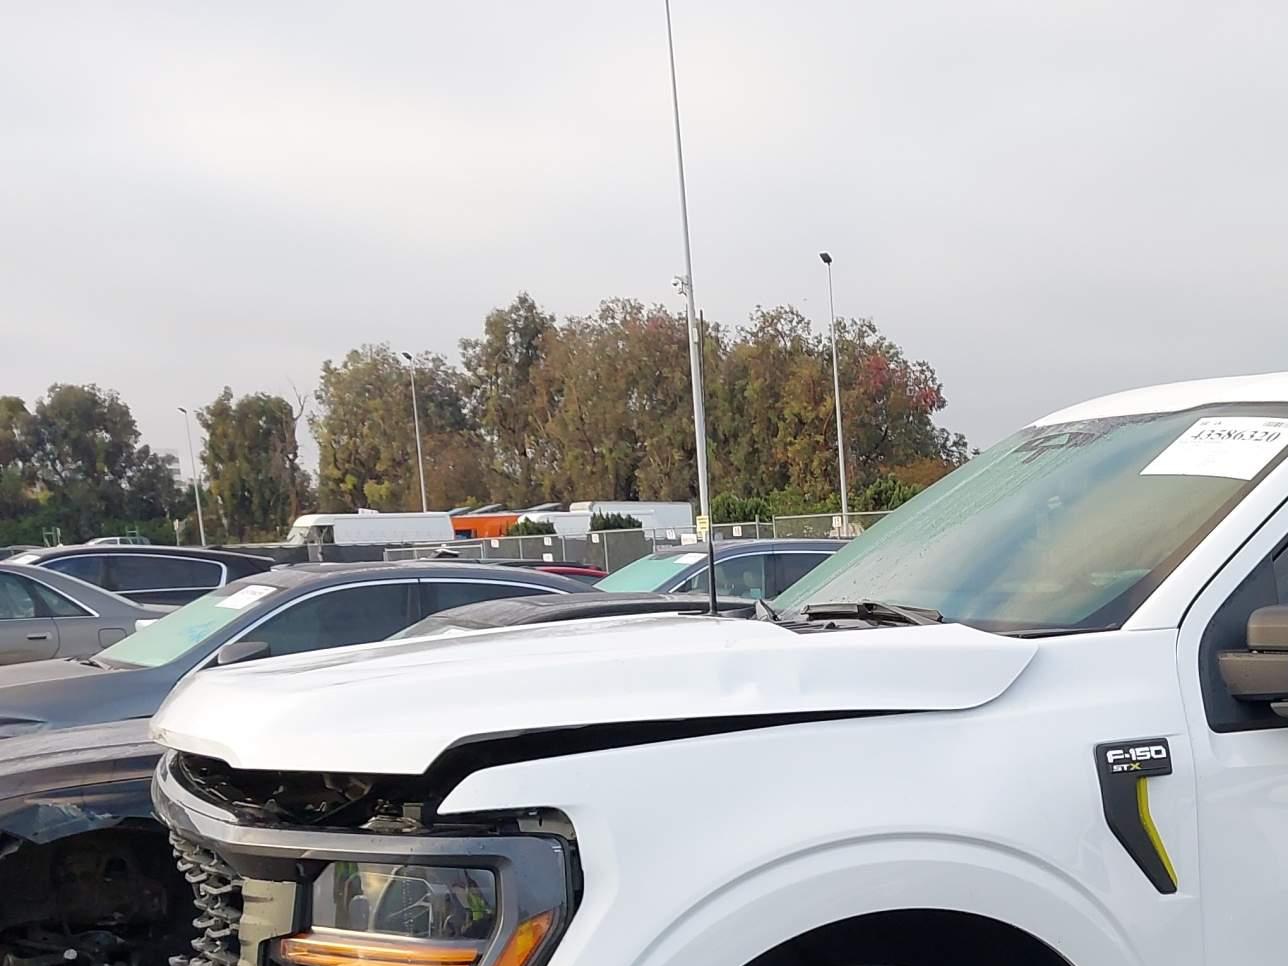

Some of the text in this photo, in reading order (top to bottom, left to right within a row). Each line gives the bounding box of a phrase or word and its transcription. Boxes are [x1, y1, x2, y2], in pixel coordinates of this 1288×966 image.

[1191, 429, 1281, 443] 43586320
[1106, 745, 1167, 764] F-150
[1112, 762, 1141, 773] STX
